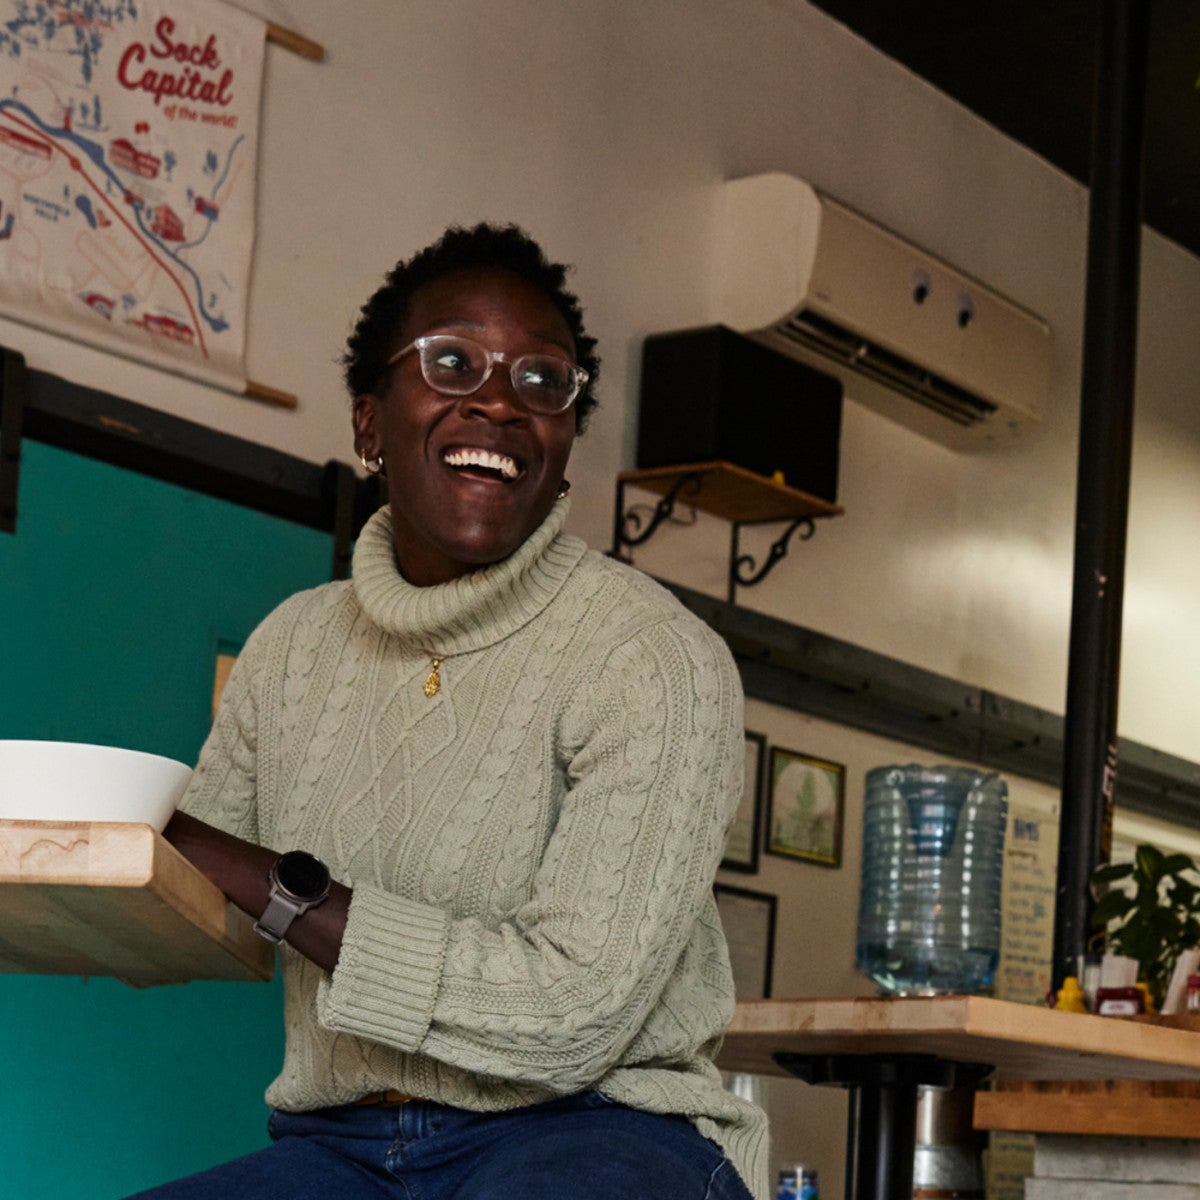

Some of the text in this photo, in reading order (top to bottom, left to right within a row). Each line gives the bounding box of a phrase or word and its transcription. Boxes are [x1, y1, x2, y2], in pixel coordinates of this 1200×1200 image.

[150, 16, 221, 70] Sock
[117, 42, 233, 106] Capital
[164, 105, 177, 121] of
[179, 107, 197, 122] the
